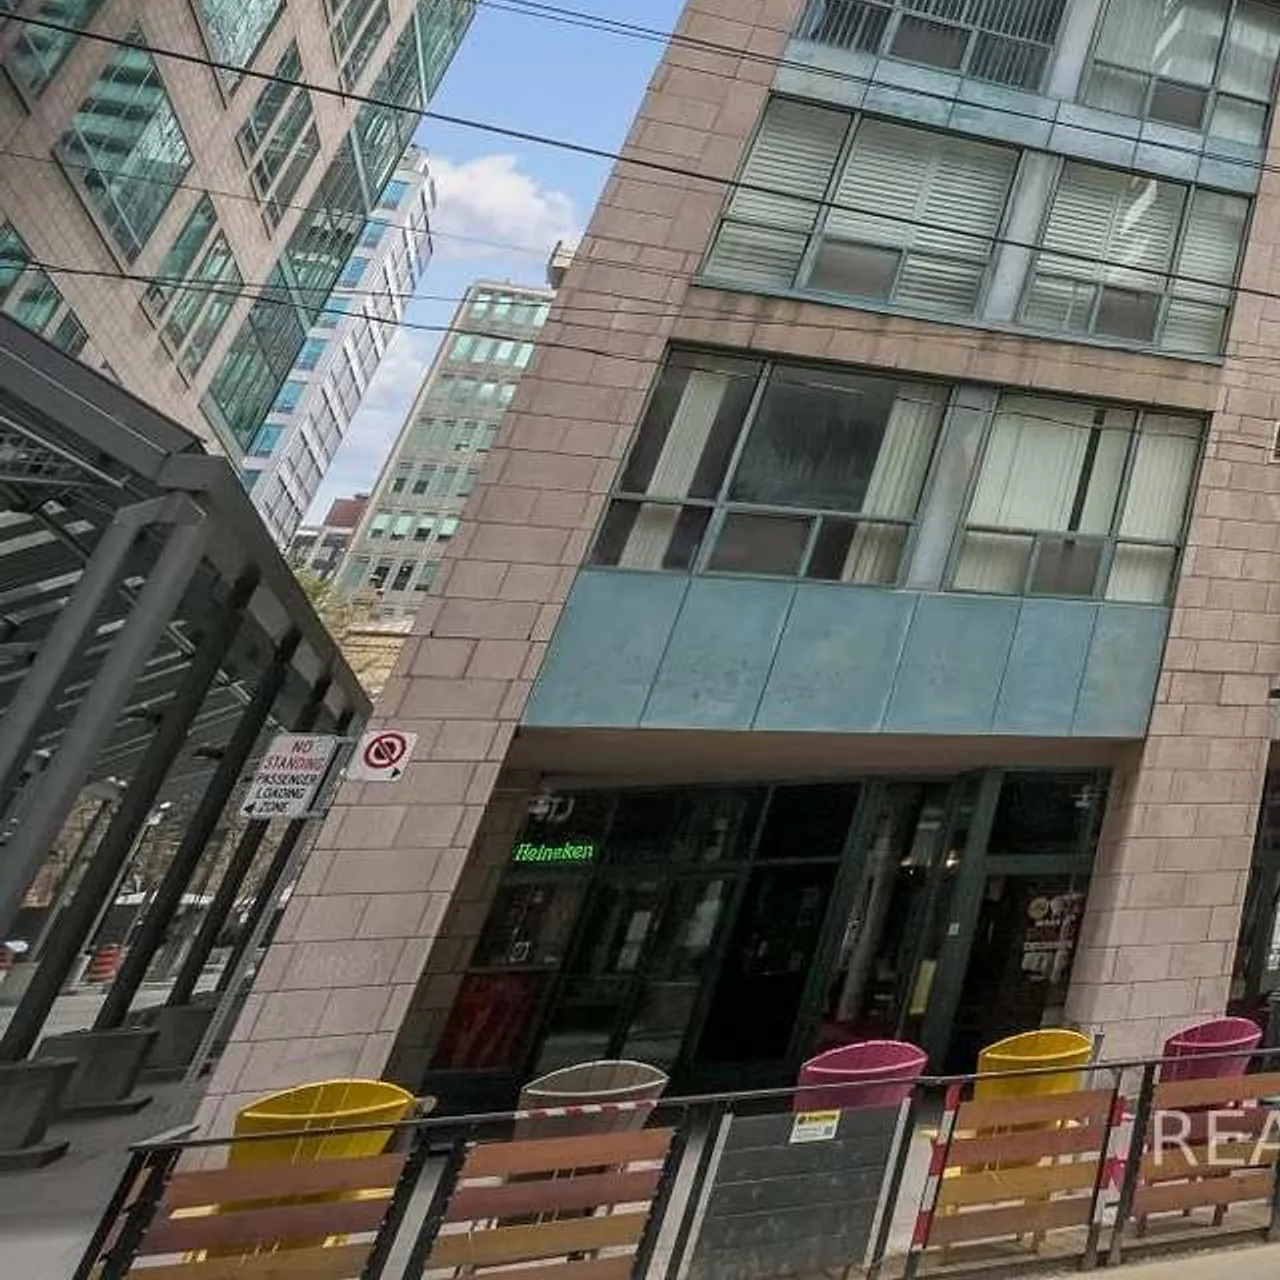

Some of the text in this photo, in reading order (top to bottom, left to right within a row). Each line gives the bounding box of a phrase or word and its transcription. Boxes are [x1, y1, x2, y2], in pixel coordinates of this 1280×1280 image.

[291, 738, 315, 754] NO
[263, 756, 326, 771] STANDING
[514, 841, 594, 862] Heineken
